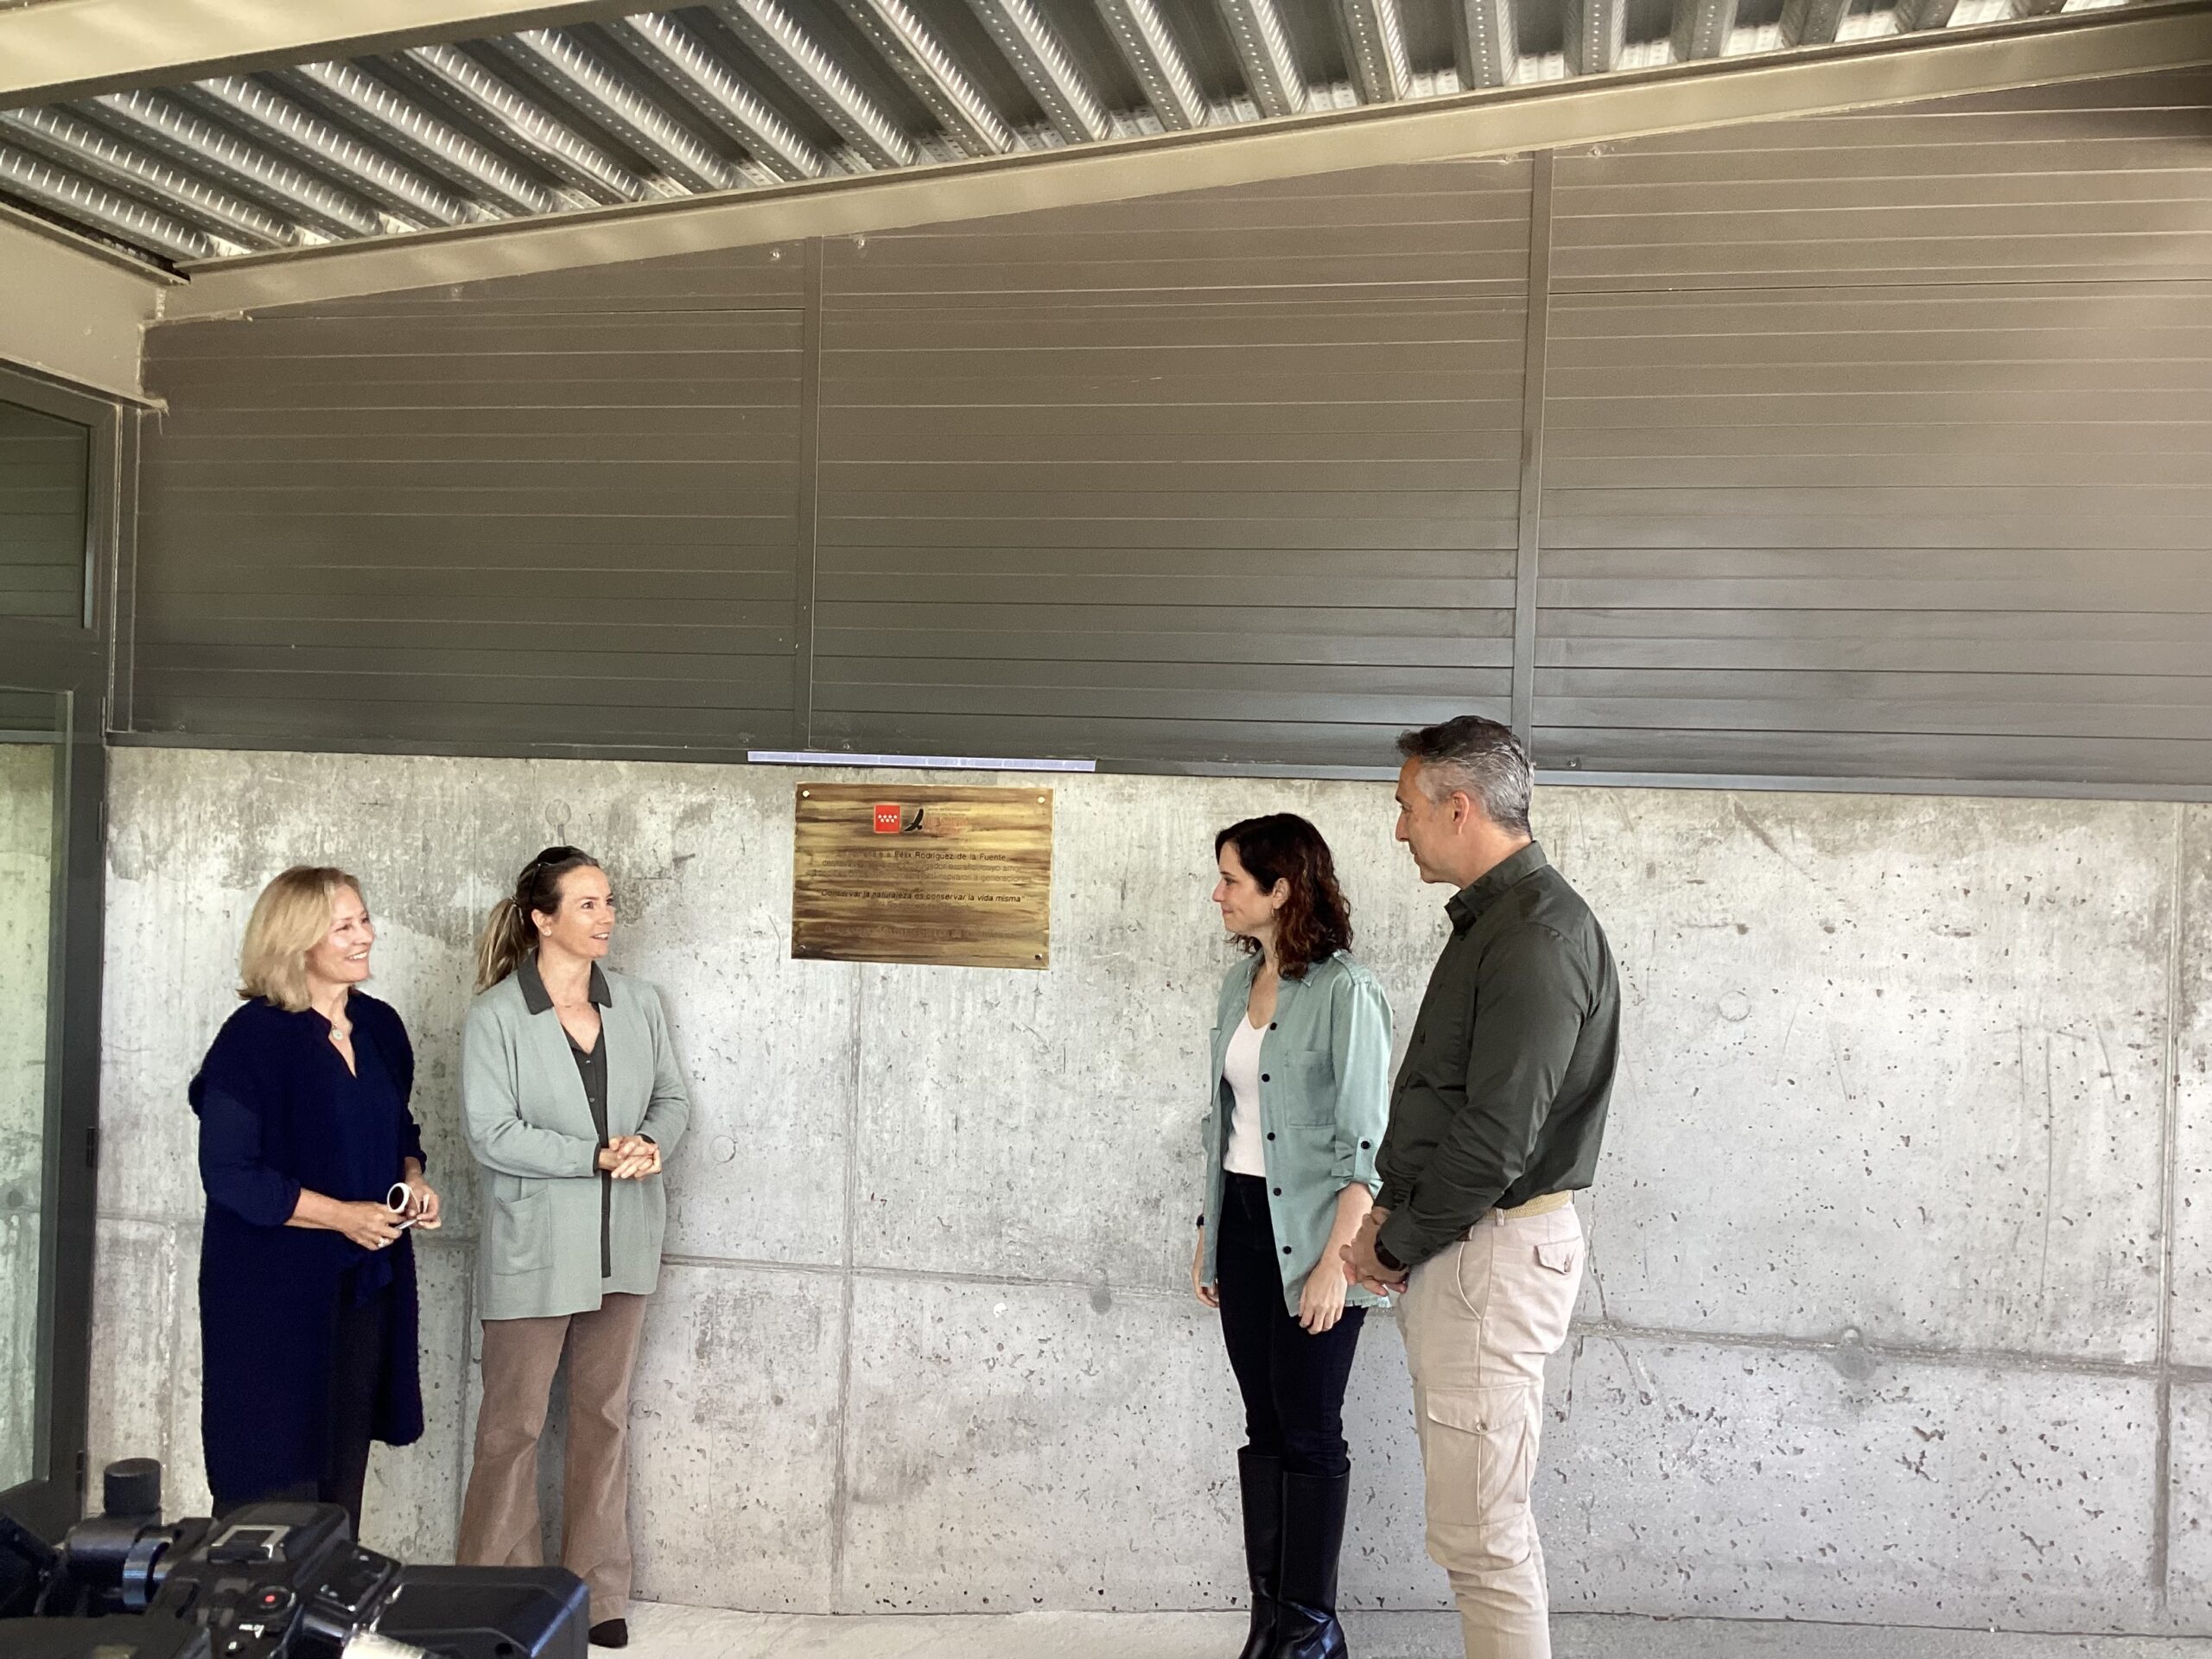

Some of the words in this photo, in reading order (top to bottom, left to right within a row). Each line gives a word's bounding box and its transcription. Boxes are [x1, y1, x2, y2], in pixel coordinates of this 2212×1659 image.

[894, 850, 912, 859] Félix
[915, 851, 953, 861] Rodríguez
[957, 852, 967, 861] de
[871, 891, 912, 899] naturaleza
[925, 893, 966, 901] conservar
